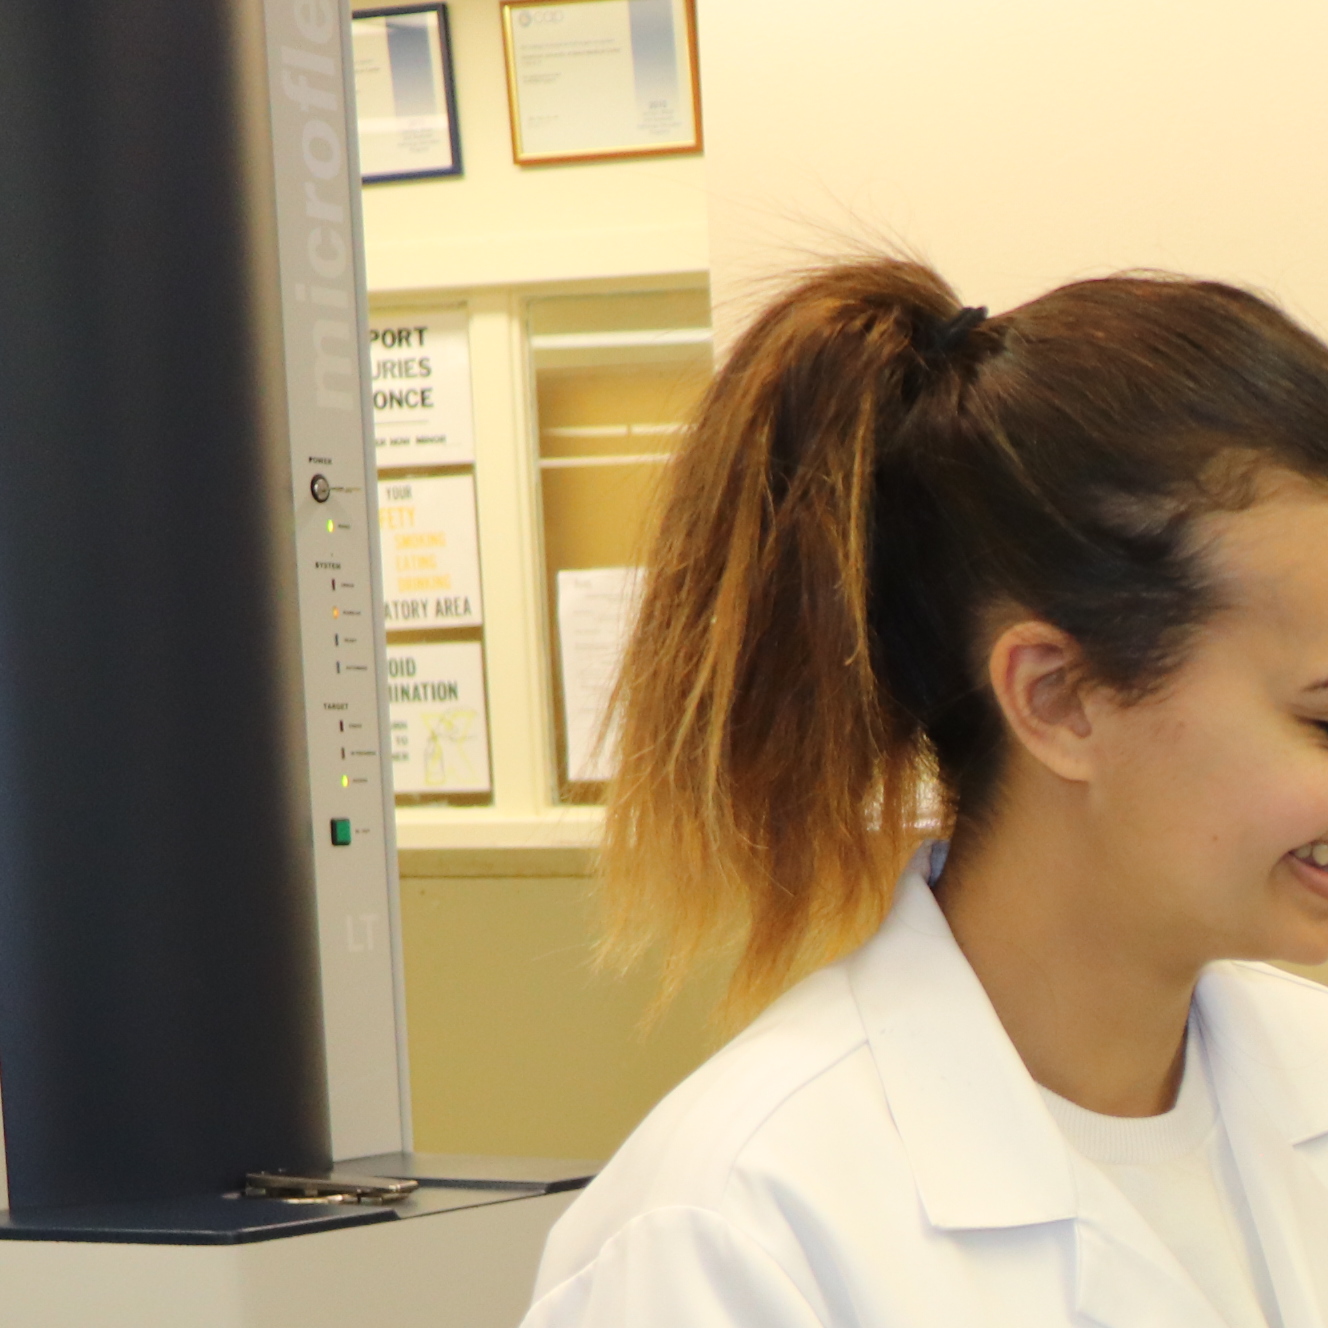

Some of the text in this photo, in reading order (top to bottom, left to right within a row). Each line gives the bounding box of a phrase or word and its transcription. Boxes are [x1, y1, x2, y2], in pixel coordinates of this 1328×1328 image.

[373, 388, 434, 411] ONCE
[309, 456, 332, 465] POWER
[386, 485, 412, 500] YOUR
[315, 562, 341, 570] SYSTEM
[435, 597, 472, 618] AREA
[388, 680, 459, 702] INATION
[346, 914, 378, 951] LT
